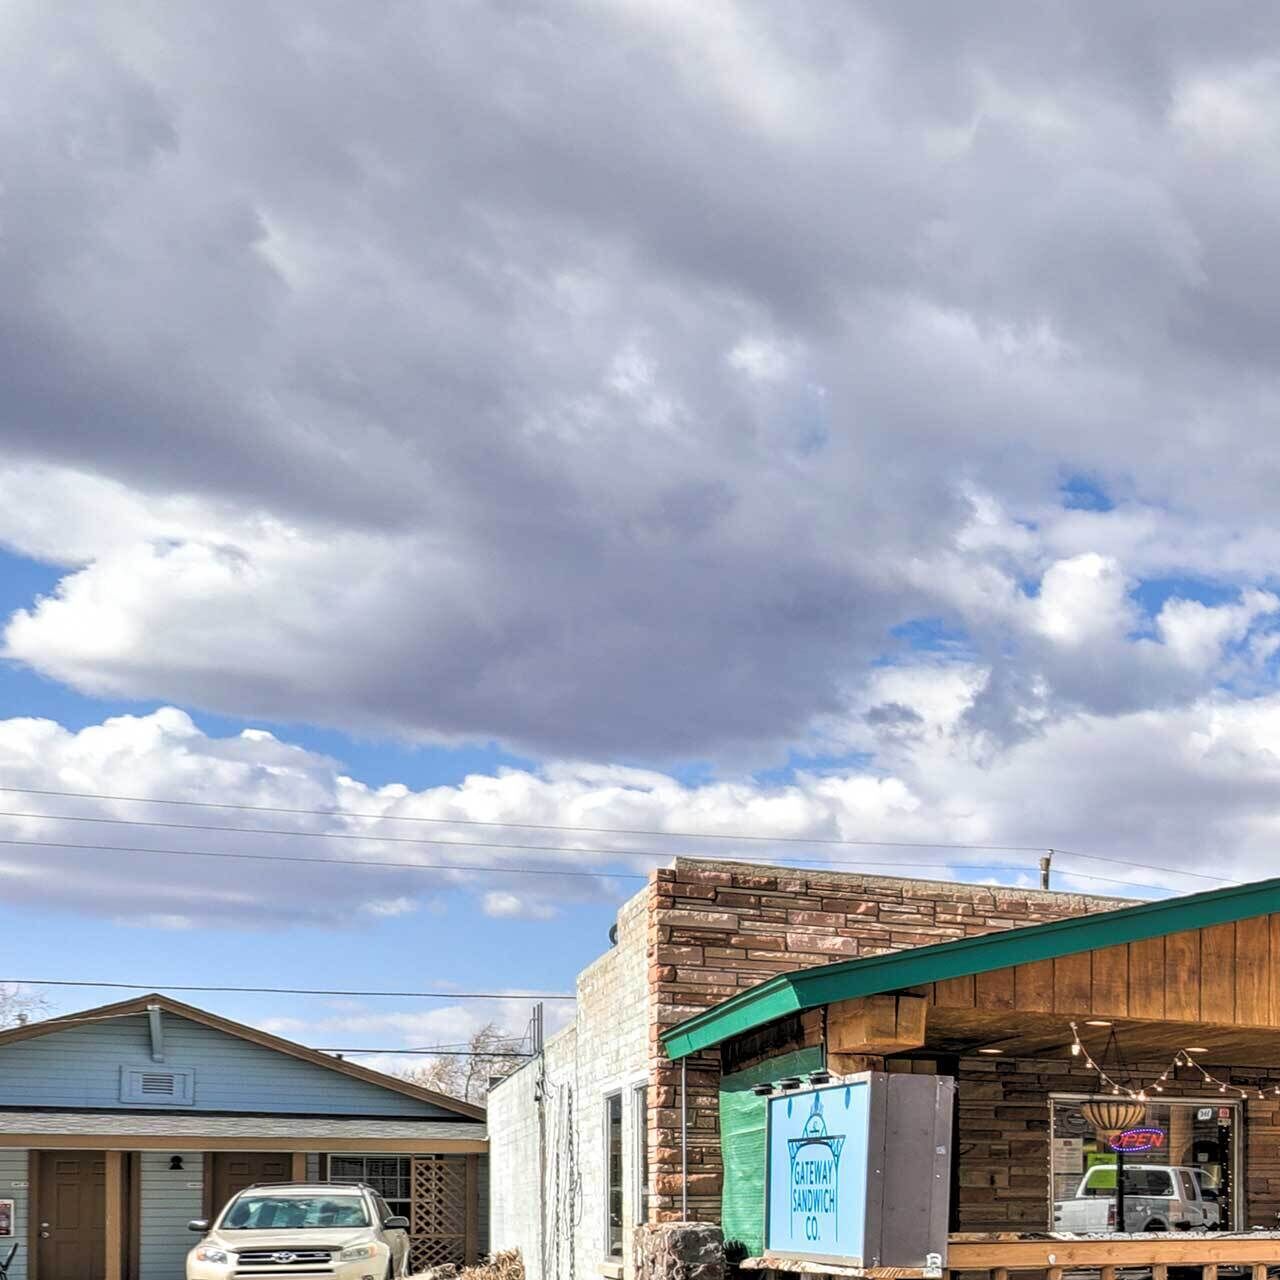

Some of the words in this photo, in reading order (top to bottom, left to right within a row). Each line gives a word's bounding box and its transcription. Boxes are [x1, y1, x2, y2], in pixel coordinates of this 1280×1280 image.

[1109, 1132, 1165, 1148] OPEN
[794, 1159, 834, 1186] GATEWAY
[793, 1188, 835, 1214] SANDWICH
[805, 1215, 821, 1241] CO.
